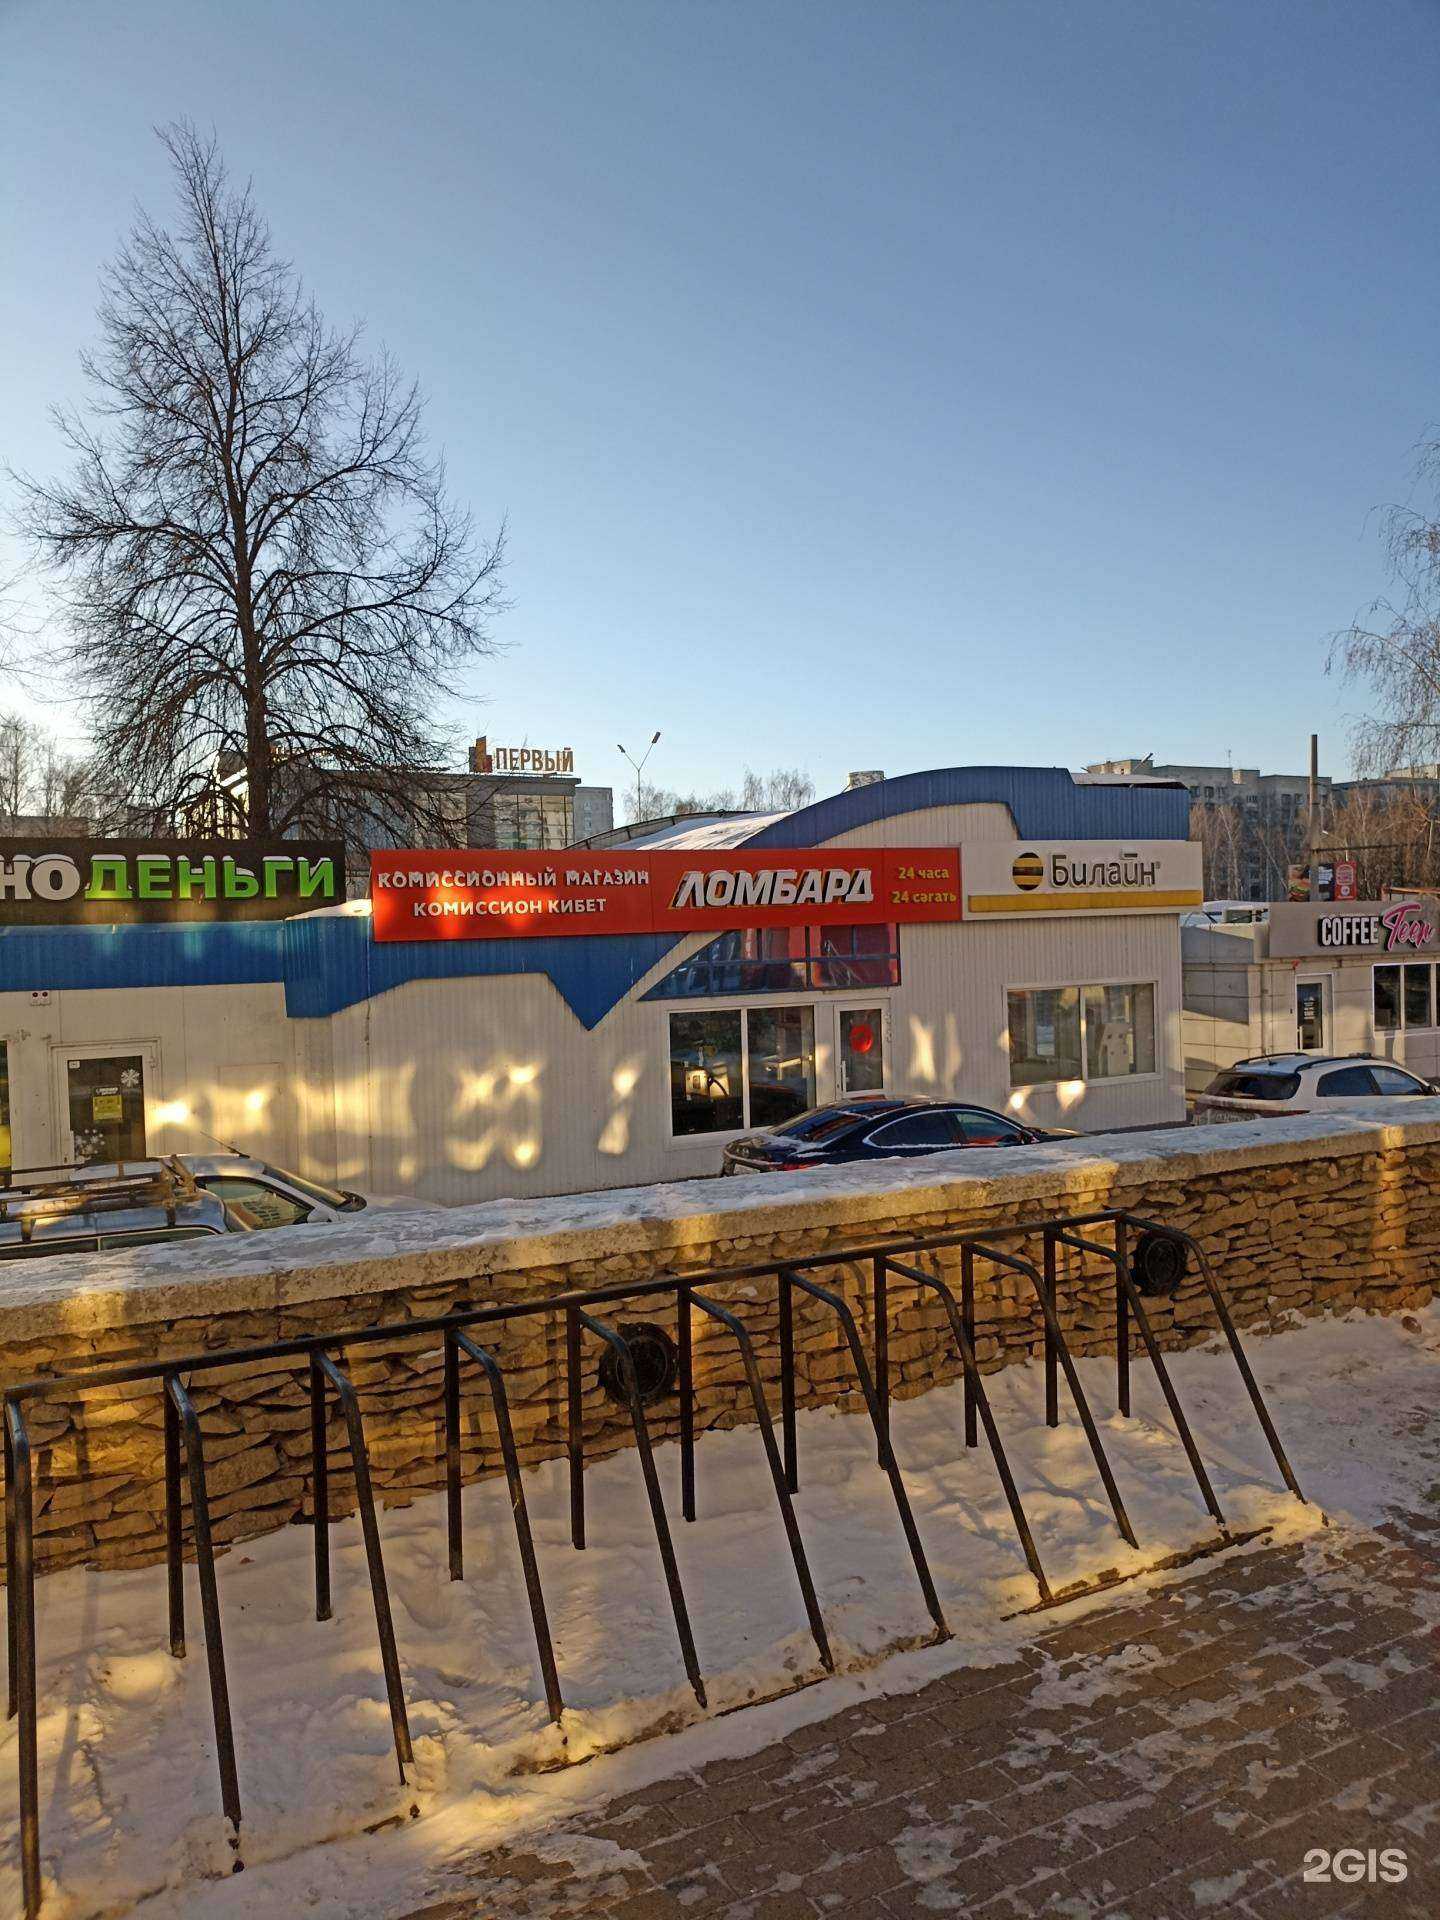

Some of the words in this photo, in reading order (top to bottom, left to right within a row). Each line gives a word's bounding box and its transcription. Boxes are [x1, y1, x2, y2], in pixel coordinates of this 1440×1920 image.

[495, 746, 574, 773] ПЕРВЫЙ
[378, 867, 557, 888] КОМИССИОННЫЙ
[565, 868, 650, 887] МАГАЗИН
[898, 866, 915, 880] 24
[918, 868, 950, 879] часа
[1051, 850, 1156, 887] Билайн
[670, 868, 874, 908] ЛОМБАРД
[892, 890, 910, 903] 24
[414, 900, 542, 917] КОМИССИОН
[547, 898, 607, 914] КИБЕТ
[1320, 915, 1379, 946] COFFEE
